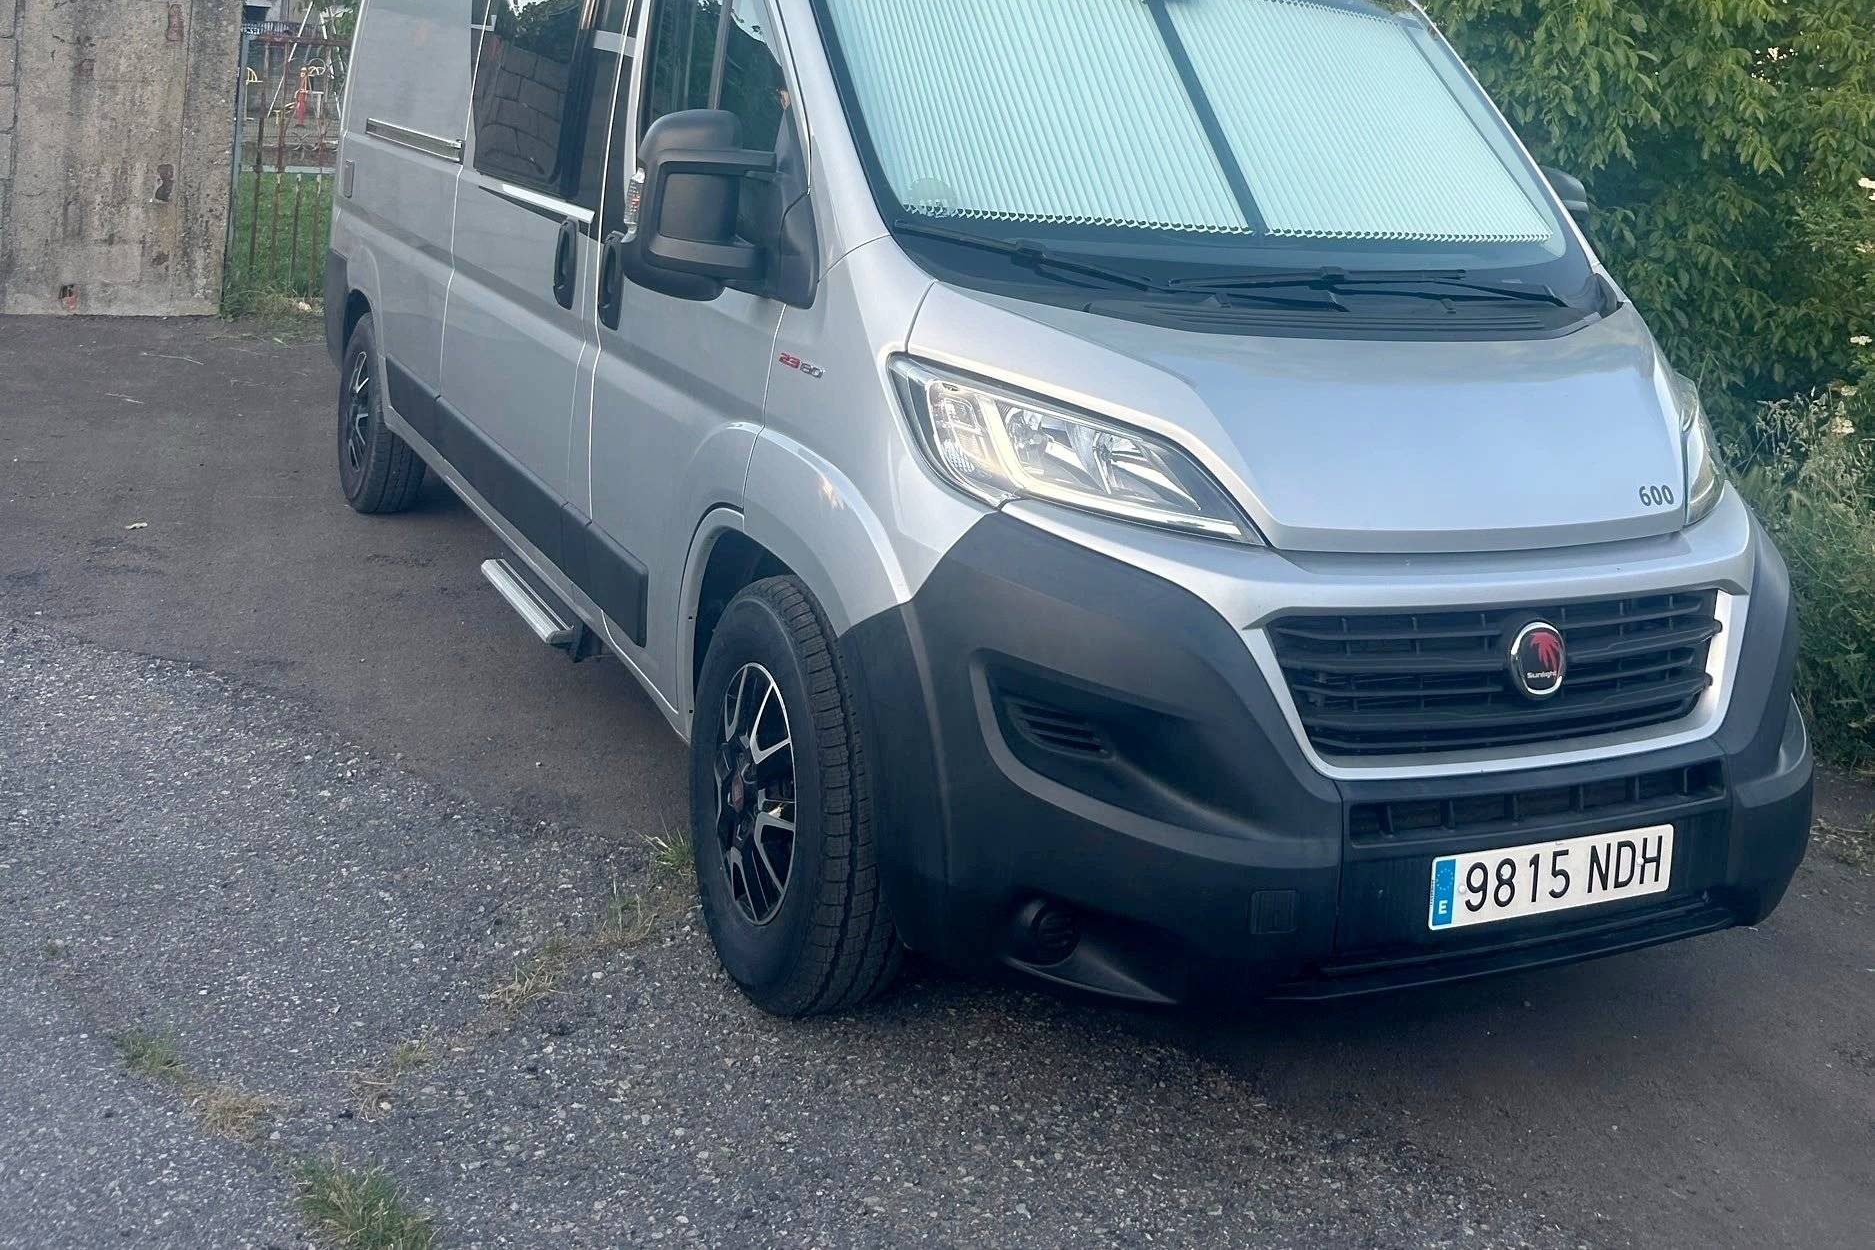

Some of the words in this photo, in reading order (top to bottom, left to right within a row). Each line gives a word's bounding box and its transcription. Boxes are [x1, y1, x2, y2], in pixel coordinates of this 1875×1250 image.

[1639, 484, 1675, 507] 600
[1526, 670, 1557, 679] Sunlight
[1438, 899, 1449, 915] E
[1464, 849, 1570, 913] 9815
[1587, 834, 1664, 894] NDH
